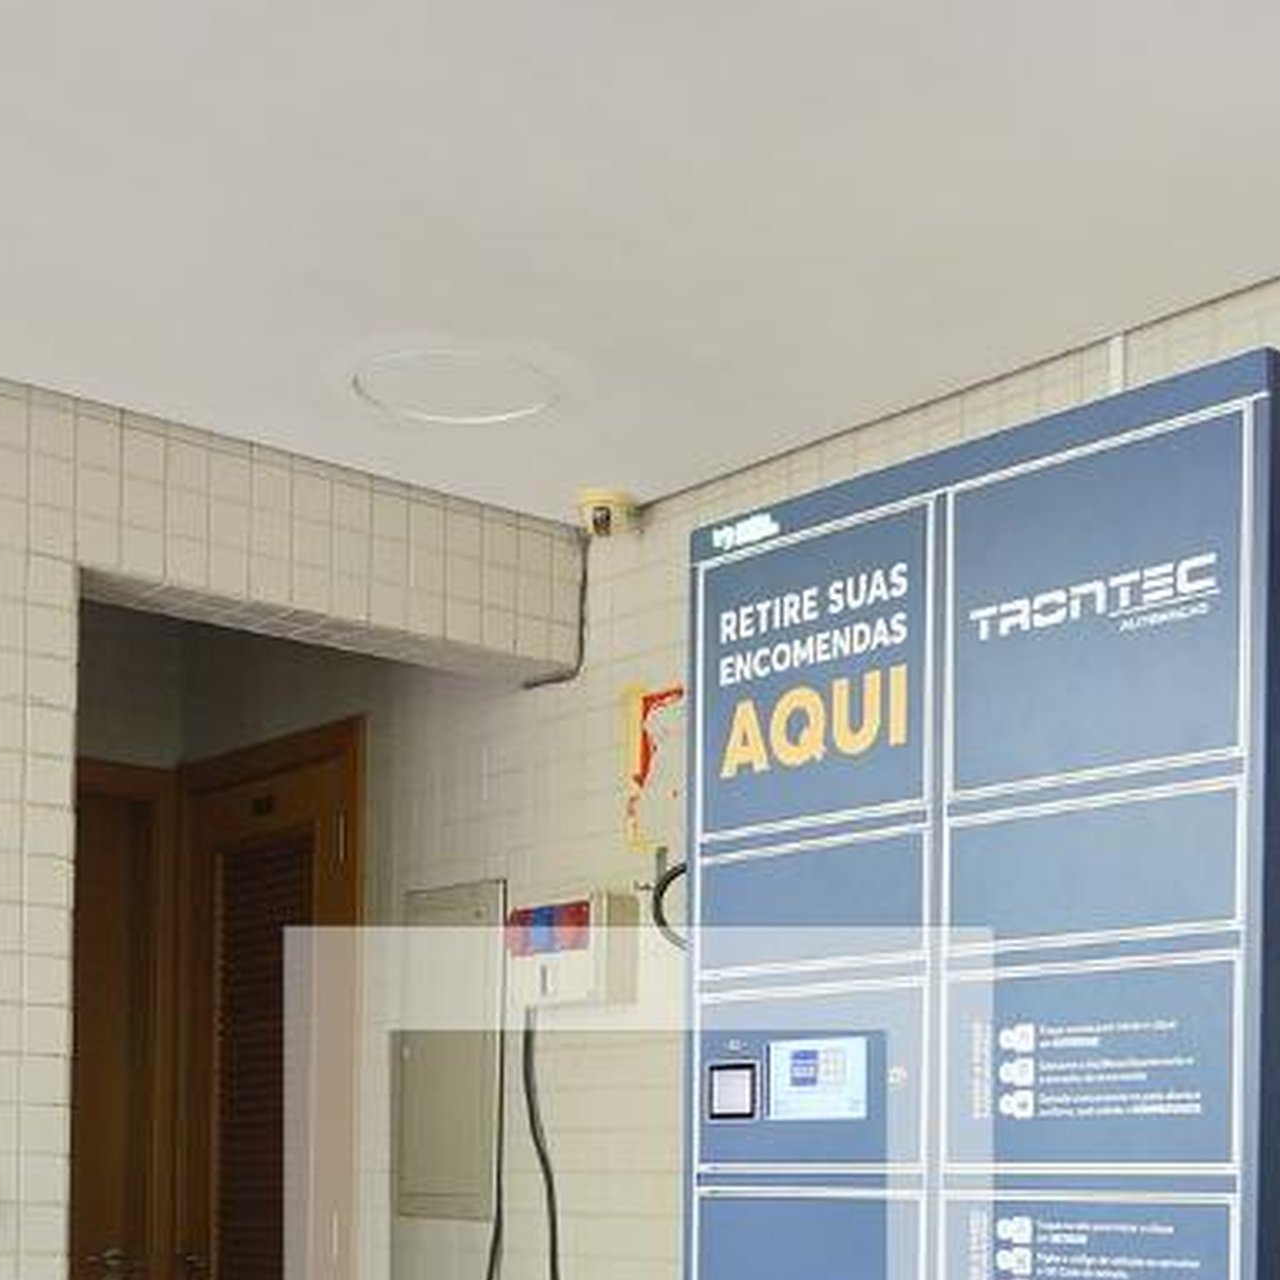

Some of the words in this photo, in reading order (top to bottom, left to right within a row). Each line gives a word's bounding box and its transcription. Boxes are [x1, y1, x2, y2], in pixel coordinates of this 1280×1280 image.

[721, 585, 819, 643] RETIRE
[828, 563, 908, 613] SUAS
[968, 552, 1218, 641] TRONTEC
[721, 612, 908, 686] ENCOMENDAS
[721, 664, 908, 779] AQUI
